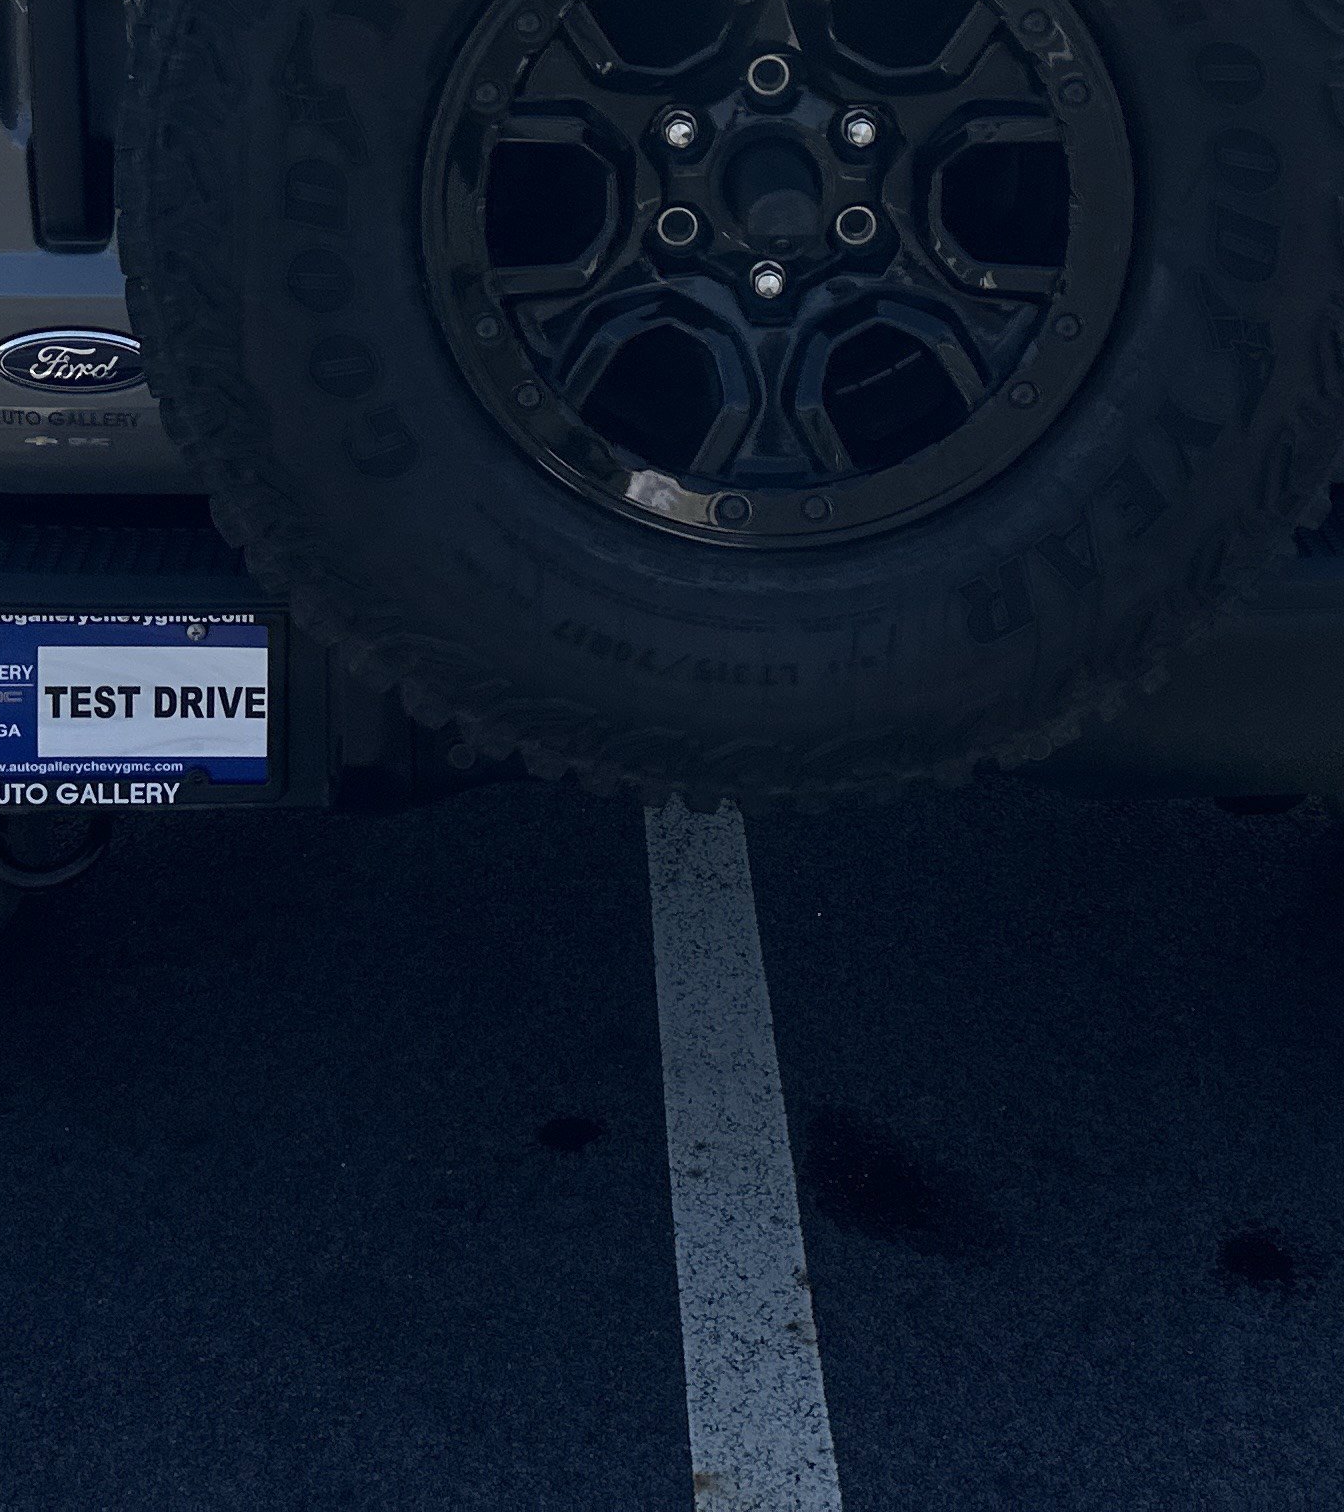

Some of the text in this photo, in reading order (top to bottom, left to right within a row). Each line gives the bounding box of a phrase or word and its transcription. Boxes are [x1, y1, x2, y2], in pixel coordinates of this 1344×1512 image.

[29, 345, 119, 381] Ford
[47, 410, 139, 428] GALLERY
[44, 685, 267, 719] TEST DRIVE
[55, 782, 181, 805] GALLERY
